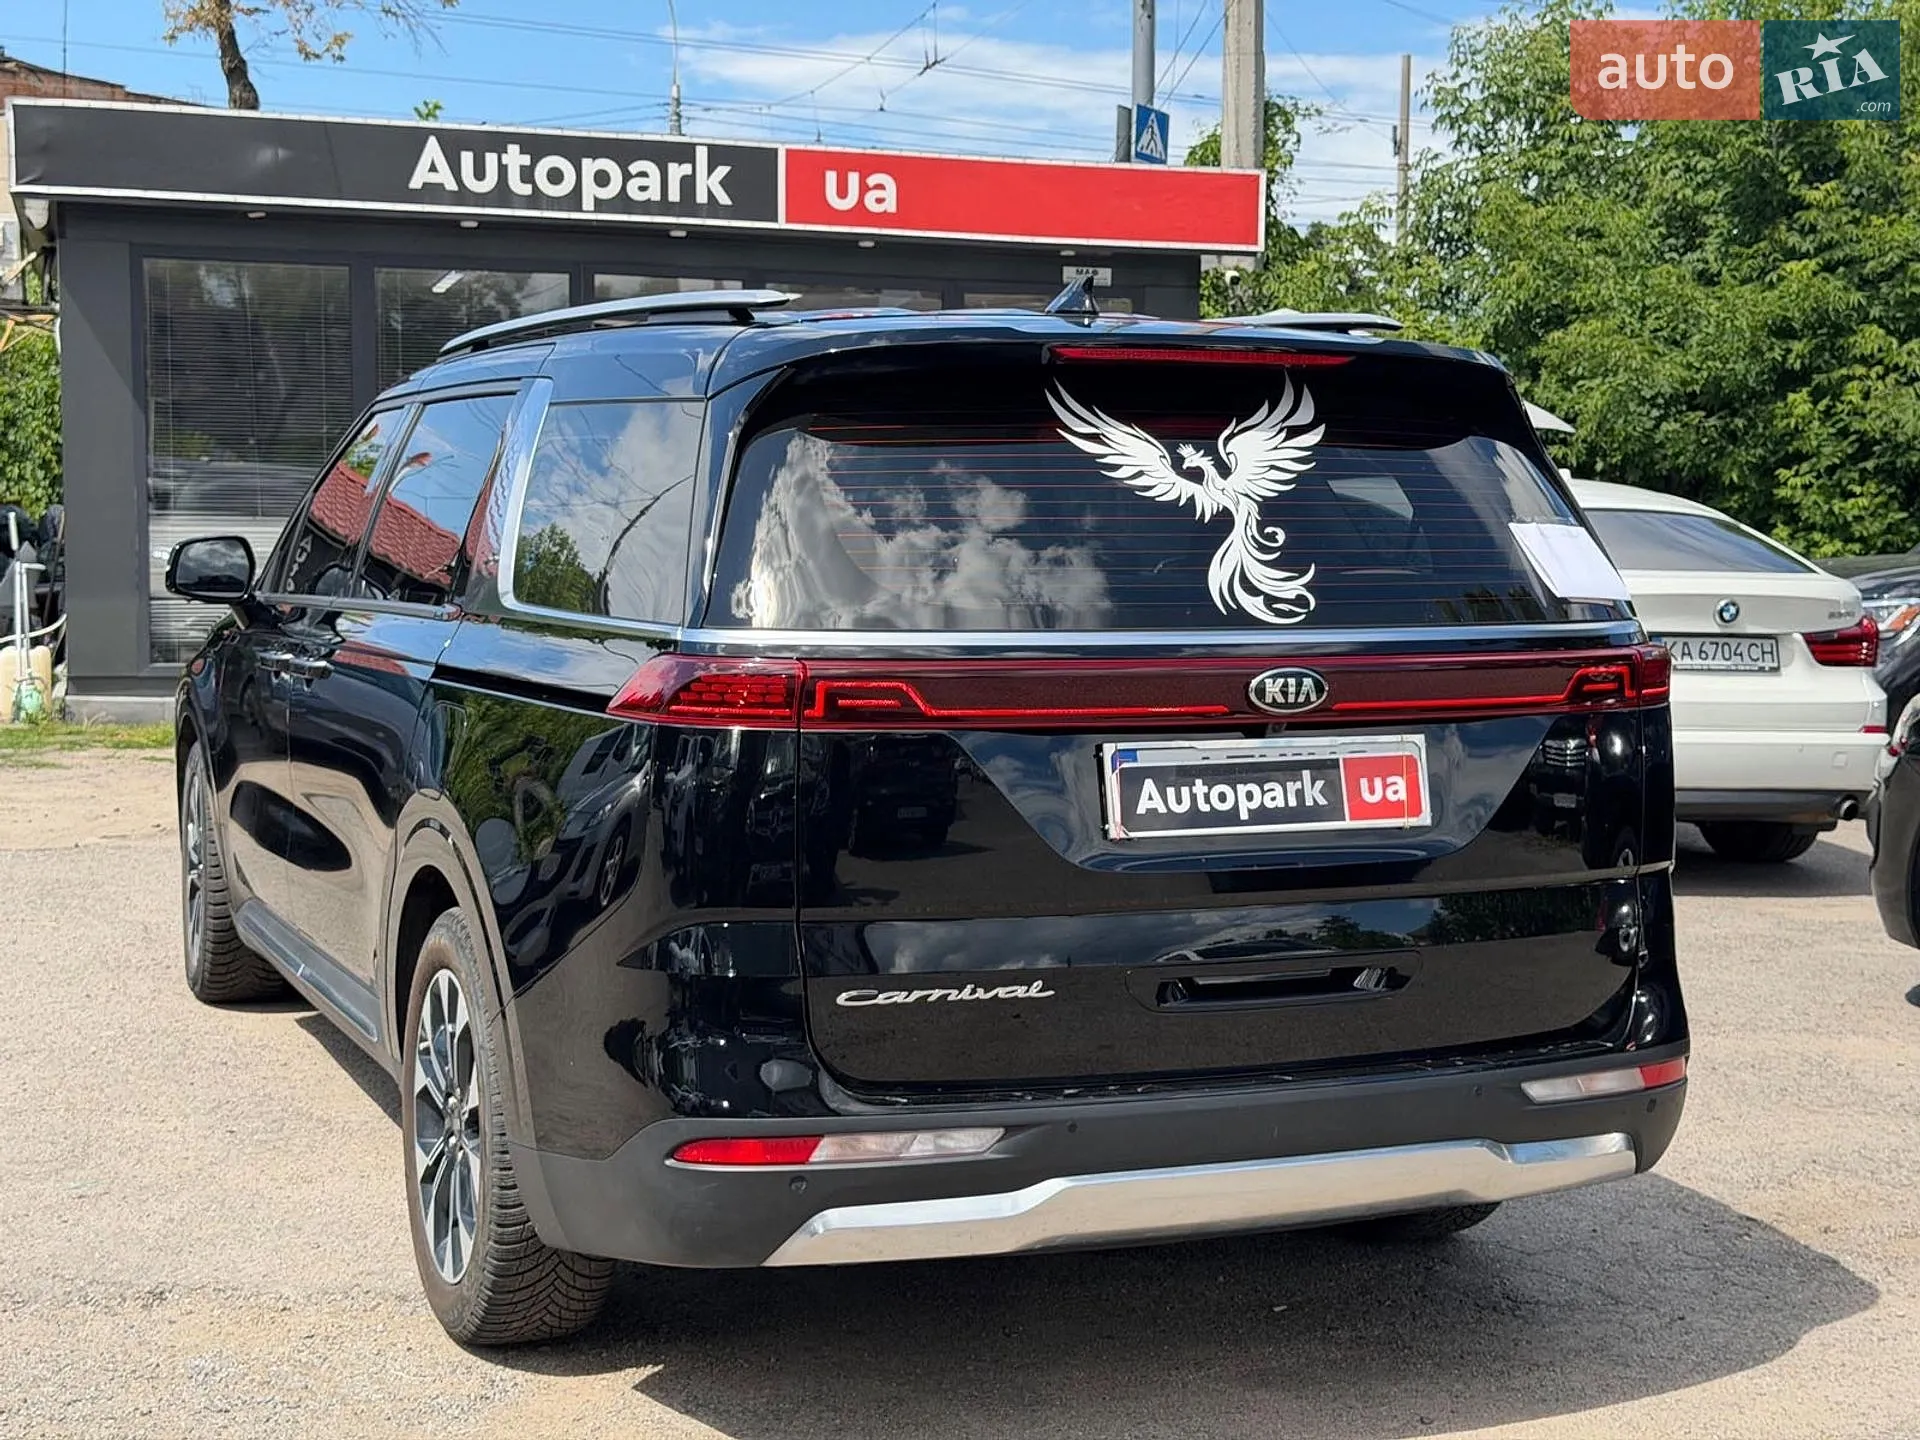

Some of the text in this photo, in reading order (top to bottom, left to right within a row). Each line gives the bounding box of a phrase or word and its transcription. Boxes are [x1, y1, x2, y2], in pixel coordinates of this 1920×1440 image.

[408, 134, 898, 214] Autopark ua
[1665, 641, 1775, 663] KA 6704 CH
[1264, 678, 1318, 704] KIA
[1135, 769, 1407, 820] Autopark ua
[836, 979, 1055, 1006] Carnival
